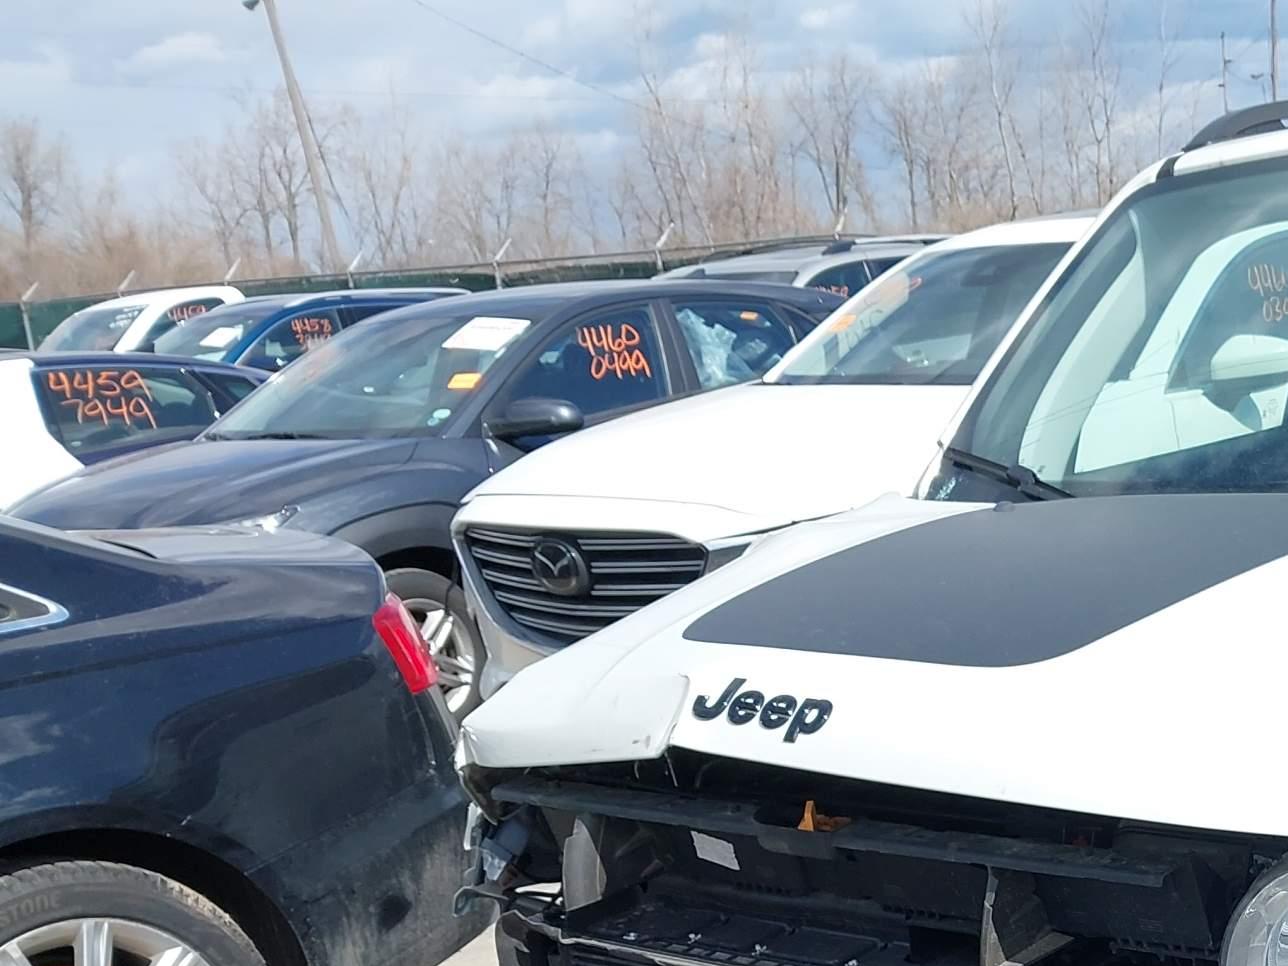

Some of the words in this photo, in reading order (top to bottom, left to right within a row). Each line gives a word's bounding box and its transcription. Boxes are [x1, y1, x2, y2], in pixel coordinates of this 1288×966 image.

[576, 323, 640, 356] 4460
[591, 348, 652, 380] 0499
[48, 370, 153, 402] 4459
[62, 397, 158, 429] 7949
[692, 677, 833, 744] Jeep
